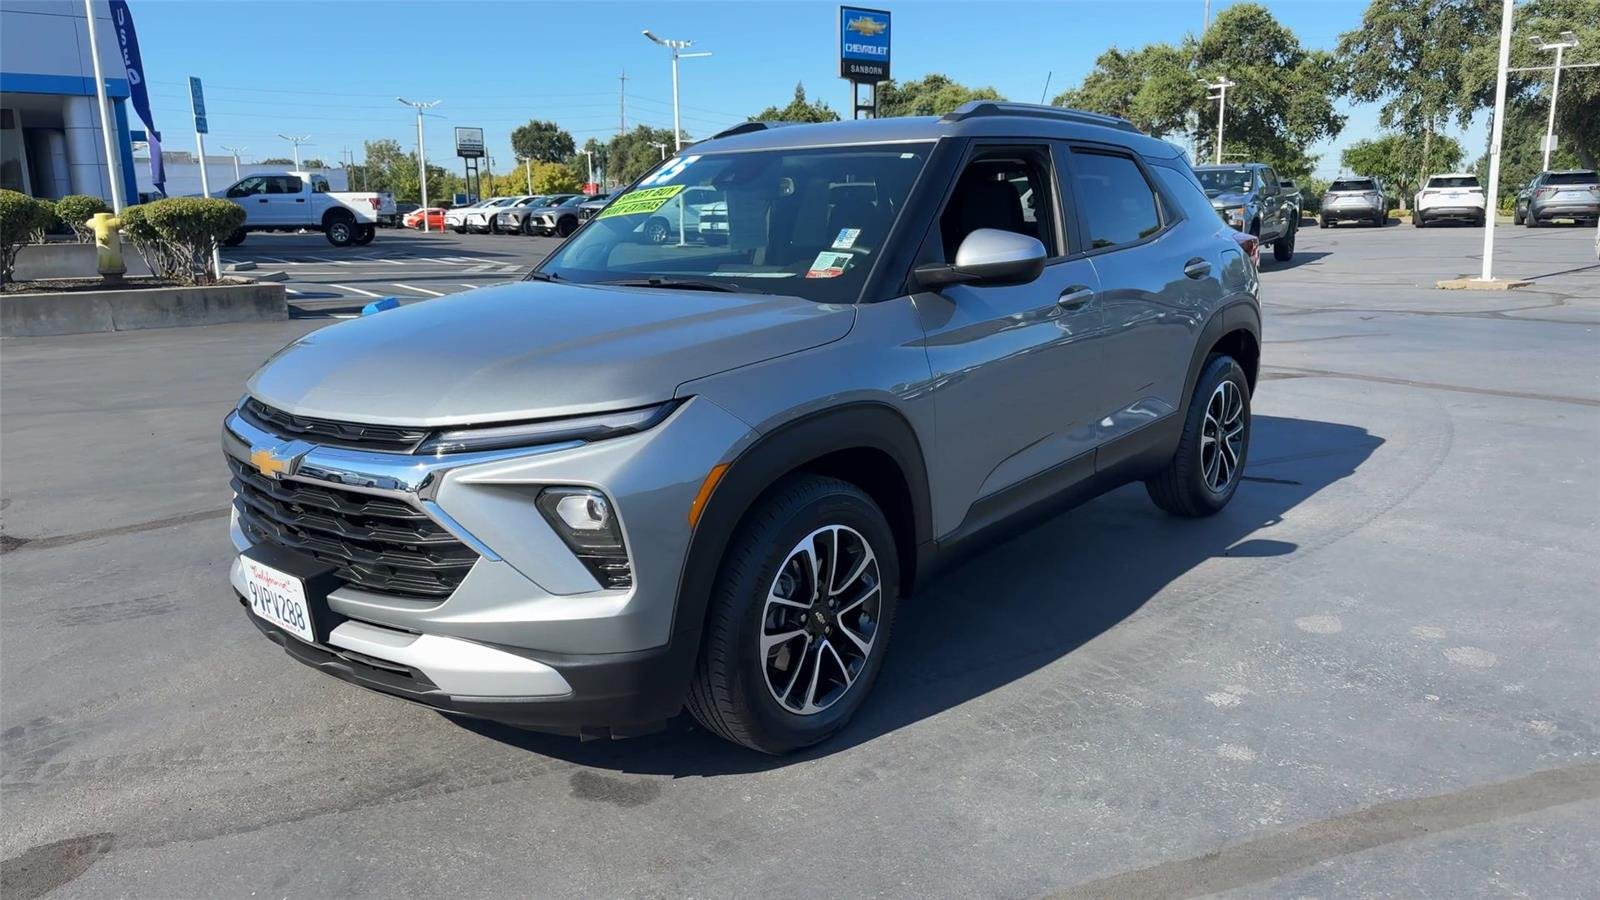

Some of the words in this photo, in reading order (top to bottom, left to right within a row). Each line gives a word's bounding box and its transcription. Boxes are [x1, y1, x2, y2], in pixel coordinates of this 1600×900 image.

[117, 8, 140, 85] USED
[845, 43, 888, 55] CHEVROLET
[850, 64, 882, 75] SANBORN
[249, 581, 305, 631] 9VPV288
